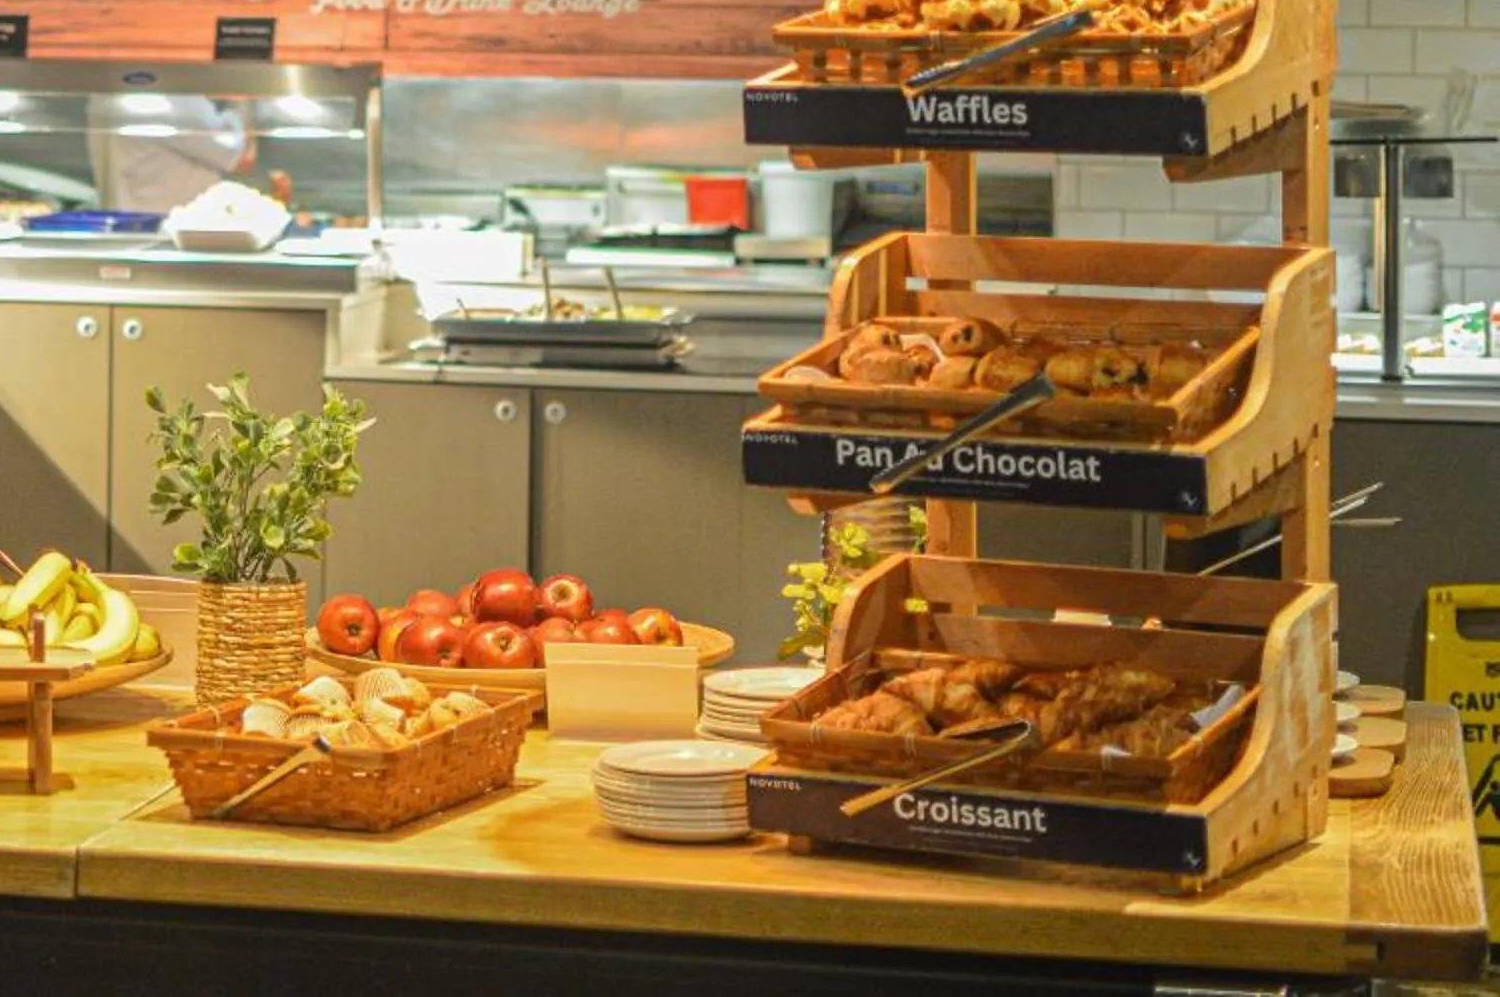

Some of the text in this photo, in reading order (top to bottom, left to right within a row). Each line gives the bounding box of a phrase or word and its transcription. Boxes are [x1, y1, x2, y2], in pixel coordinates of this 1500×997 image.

[906, 94, 1029, 125] Waffles
[834, 438, 893, 468] Pan
[953, 442, 1102, 482] Chocolat
[1450, 691, 1500, 711] CAU
[1462, 723, 1487, 743] ET
[749, 778, 803, 791] NOVOTEL
[892, 791, 1047, 834] Croissant
